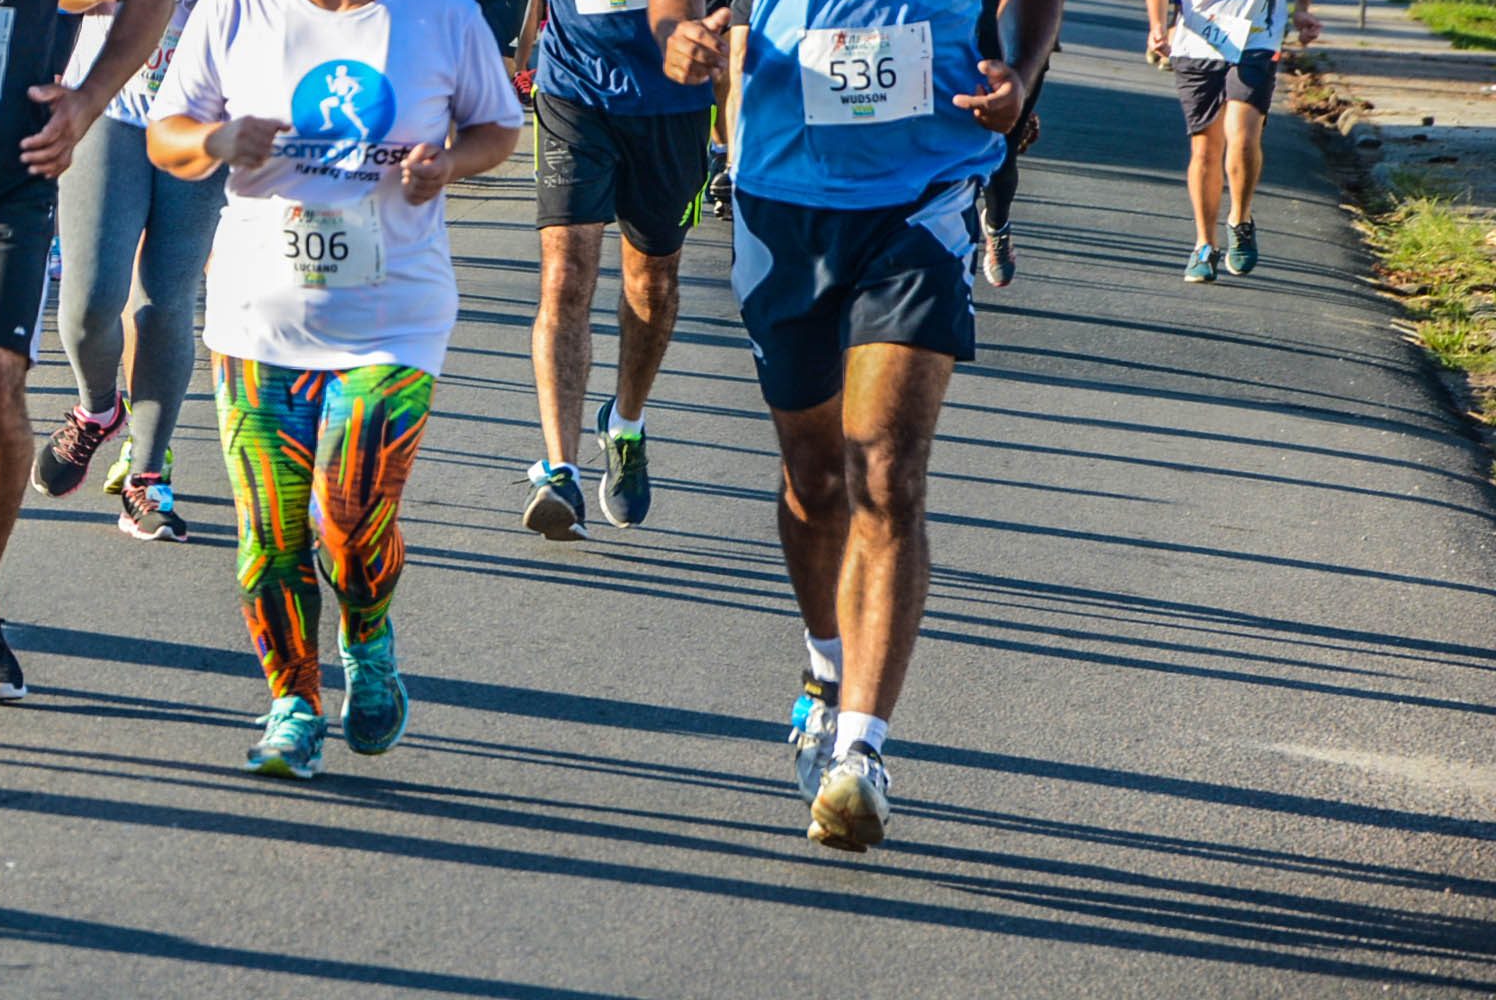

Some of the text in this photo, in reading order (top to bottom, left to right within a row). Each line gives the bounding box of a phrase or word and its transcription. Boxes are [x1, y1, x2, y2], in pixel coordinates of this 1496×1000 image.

[829, 57, 896, 91] 536
[840, 93, 887, 104] WUDSON
[296, 163, 341, 179] running
[283, 229, 349, 261] 306
[294, 263, 338, 273] LUCIANO
